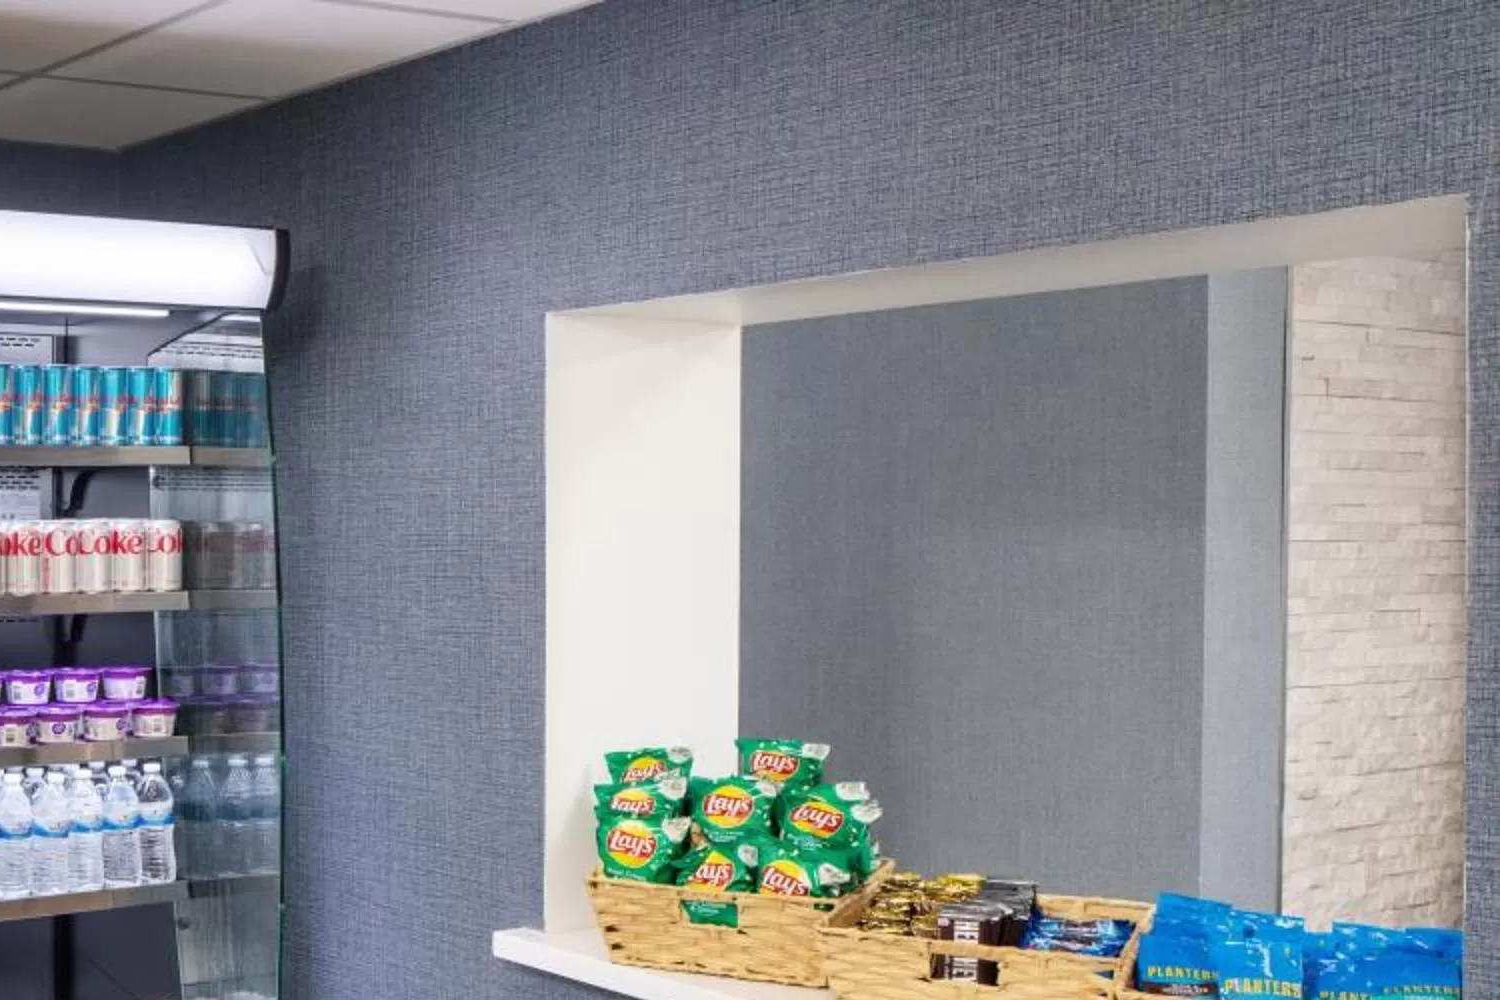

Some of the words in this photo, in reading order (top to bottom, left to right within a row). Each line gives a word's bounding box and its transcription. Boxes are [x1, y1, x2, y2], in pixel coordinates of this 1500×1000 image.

[706, 794, 753, 816] Lay's
[609, 830, 656, 858] Lay's
[1223, 977, 1302, 999] PLANTERS
